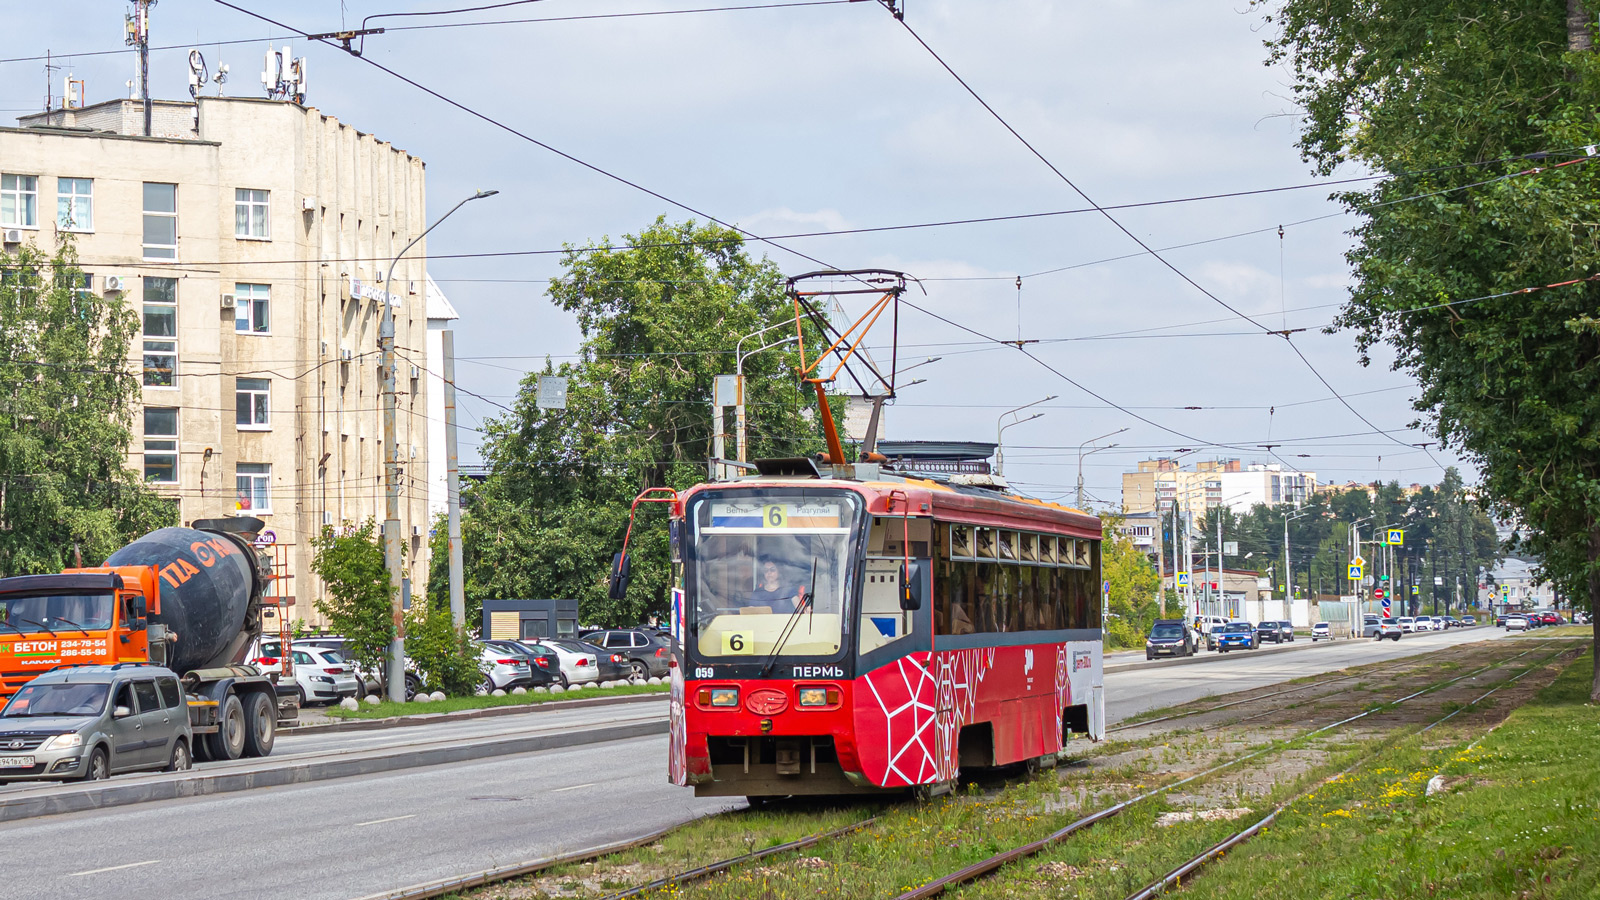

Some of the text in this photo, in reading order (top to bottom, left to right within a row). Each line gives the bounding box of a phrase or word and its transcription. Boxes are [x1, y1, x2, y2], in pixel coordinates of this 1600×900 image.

[768, 506, 782, 527] 6
[14, 641, 58, 653] БЕТОН
[61, 640, 107, 648] 234-79-54
[729, 634, 744, 651] 6
[695, 667, 714, 678] 059
[793, 667, 844, 678] ПЕРМЬ
